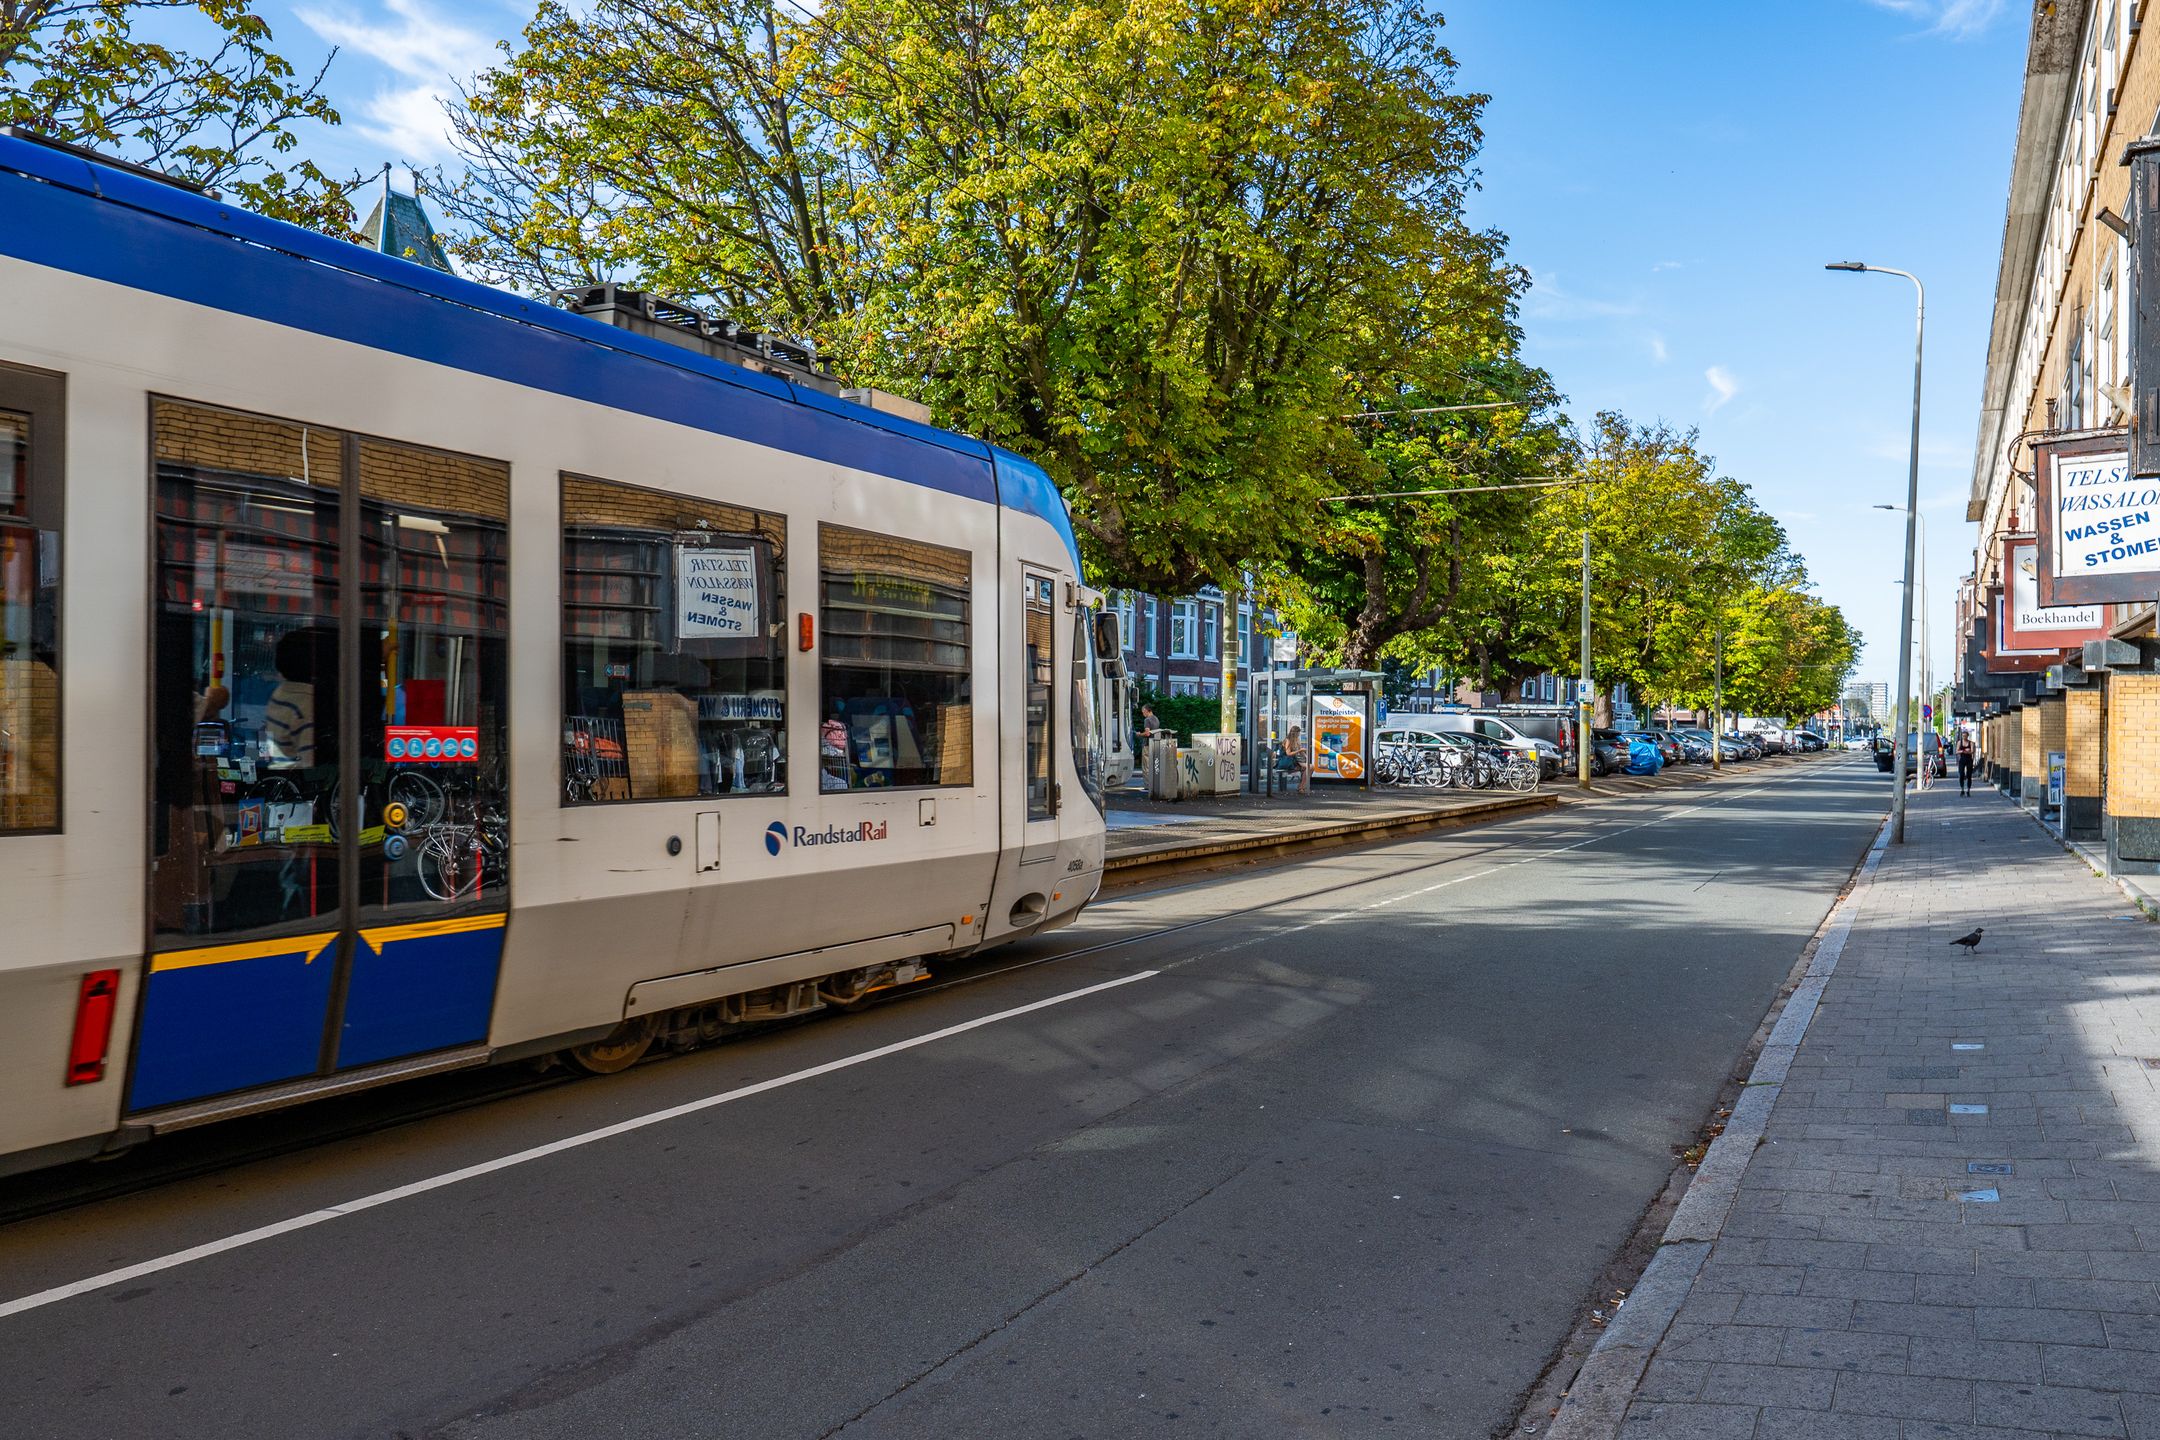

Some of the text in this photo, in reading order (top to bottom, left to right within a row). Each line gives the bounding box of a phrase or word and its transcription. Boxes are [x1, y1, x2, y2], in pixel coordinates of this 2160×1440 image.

[2067, 466, 2129, 487] TELST
[2064, 511, 2151, 542] WASSEN
[2110, 532, 2124, 545] &
[2084, 538, 2160, 567] STOME
[2022, 611, 2095, 625] Boekhandel
[793, 820, 887, 847] RandstadRail
